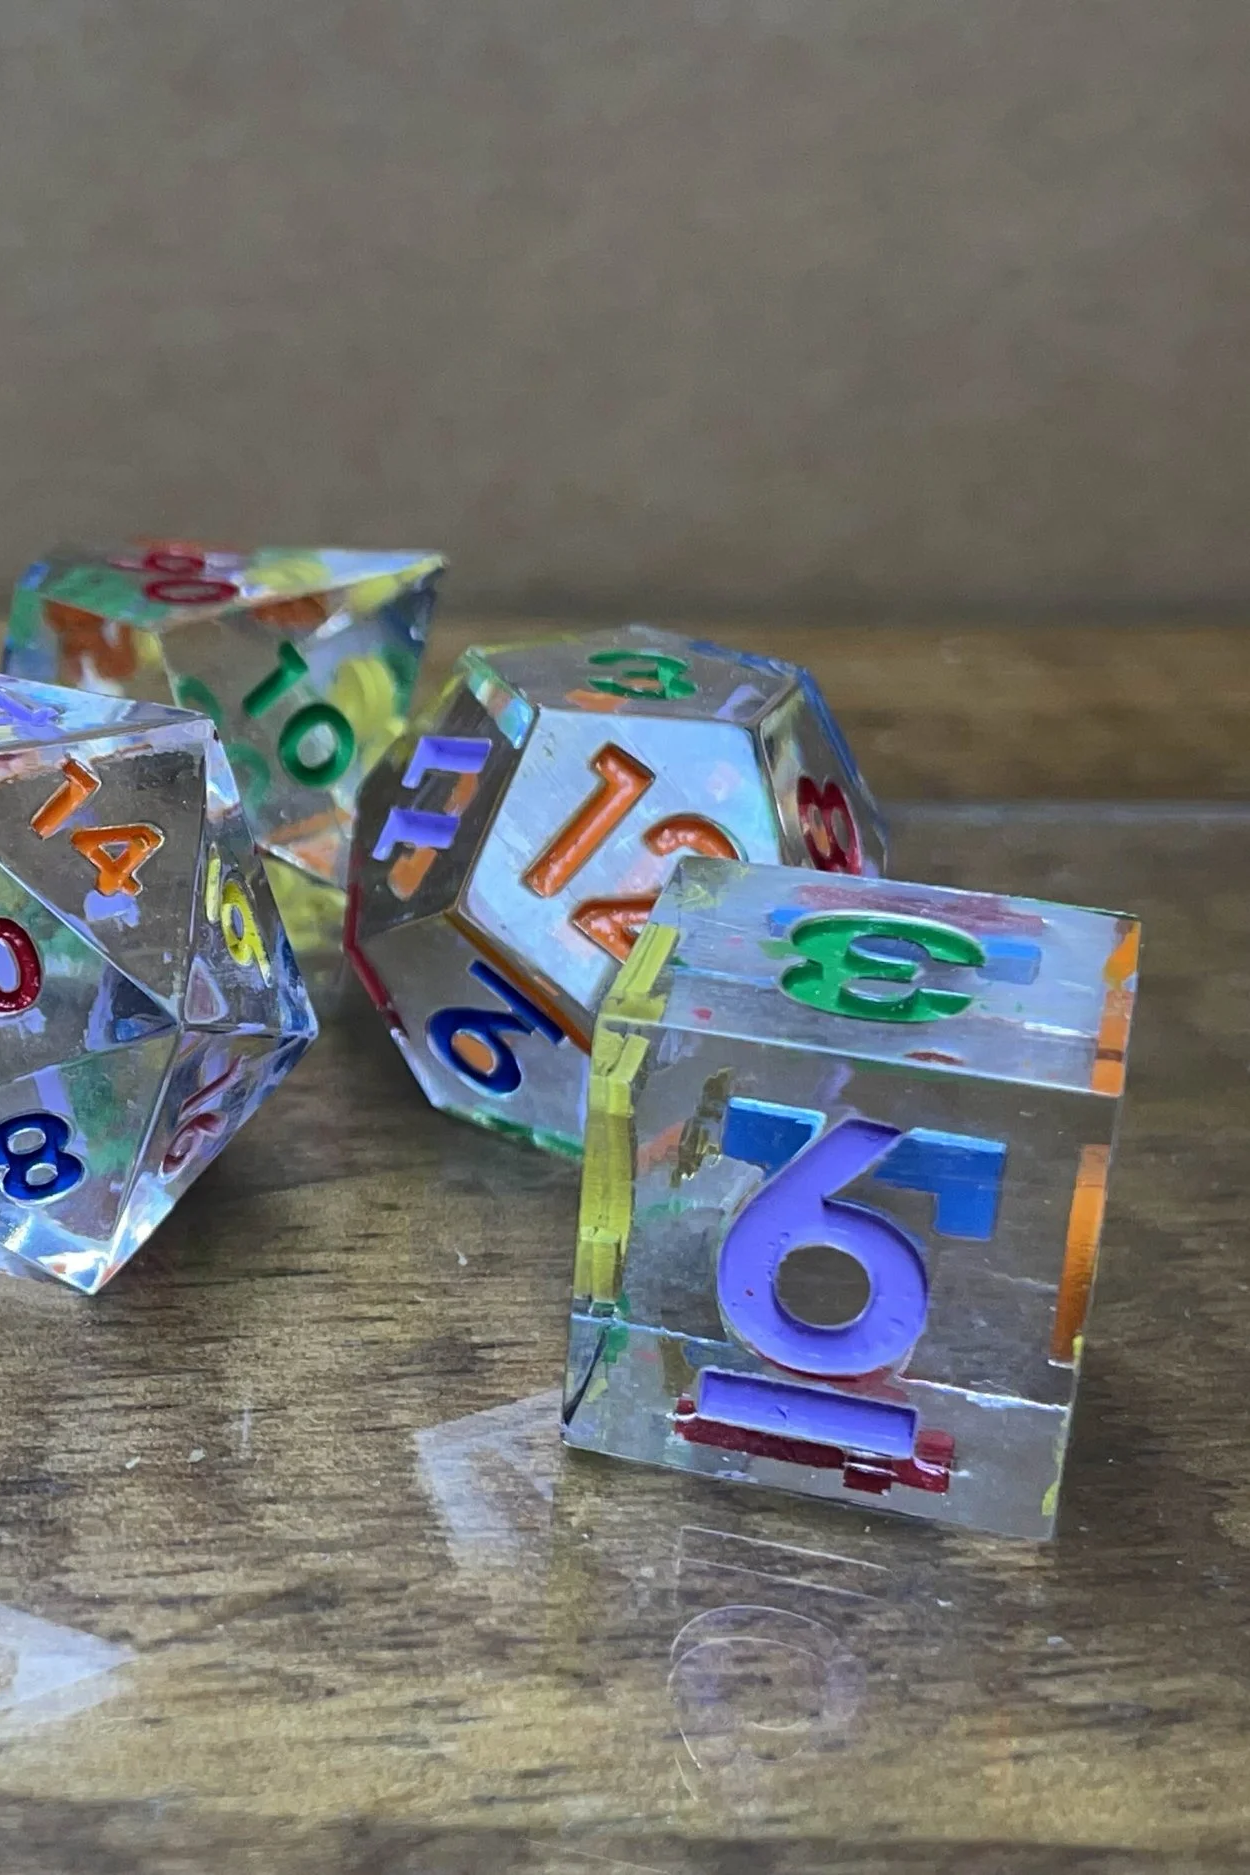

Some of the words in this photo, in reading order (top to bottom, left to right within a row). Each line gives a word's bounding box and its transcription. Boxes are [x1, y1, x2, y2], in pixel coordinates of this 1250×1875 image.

[242, 640, 355, 787] 10
[30, 757, 166, 896] 14
[520, 740, 742, 965] 12
[778, 909, 987, 1024] 3
[716, 1116, 929, 1377] 6
